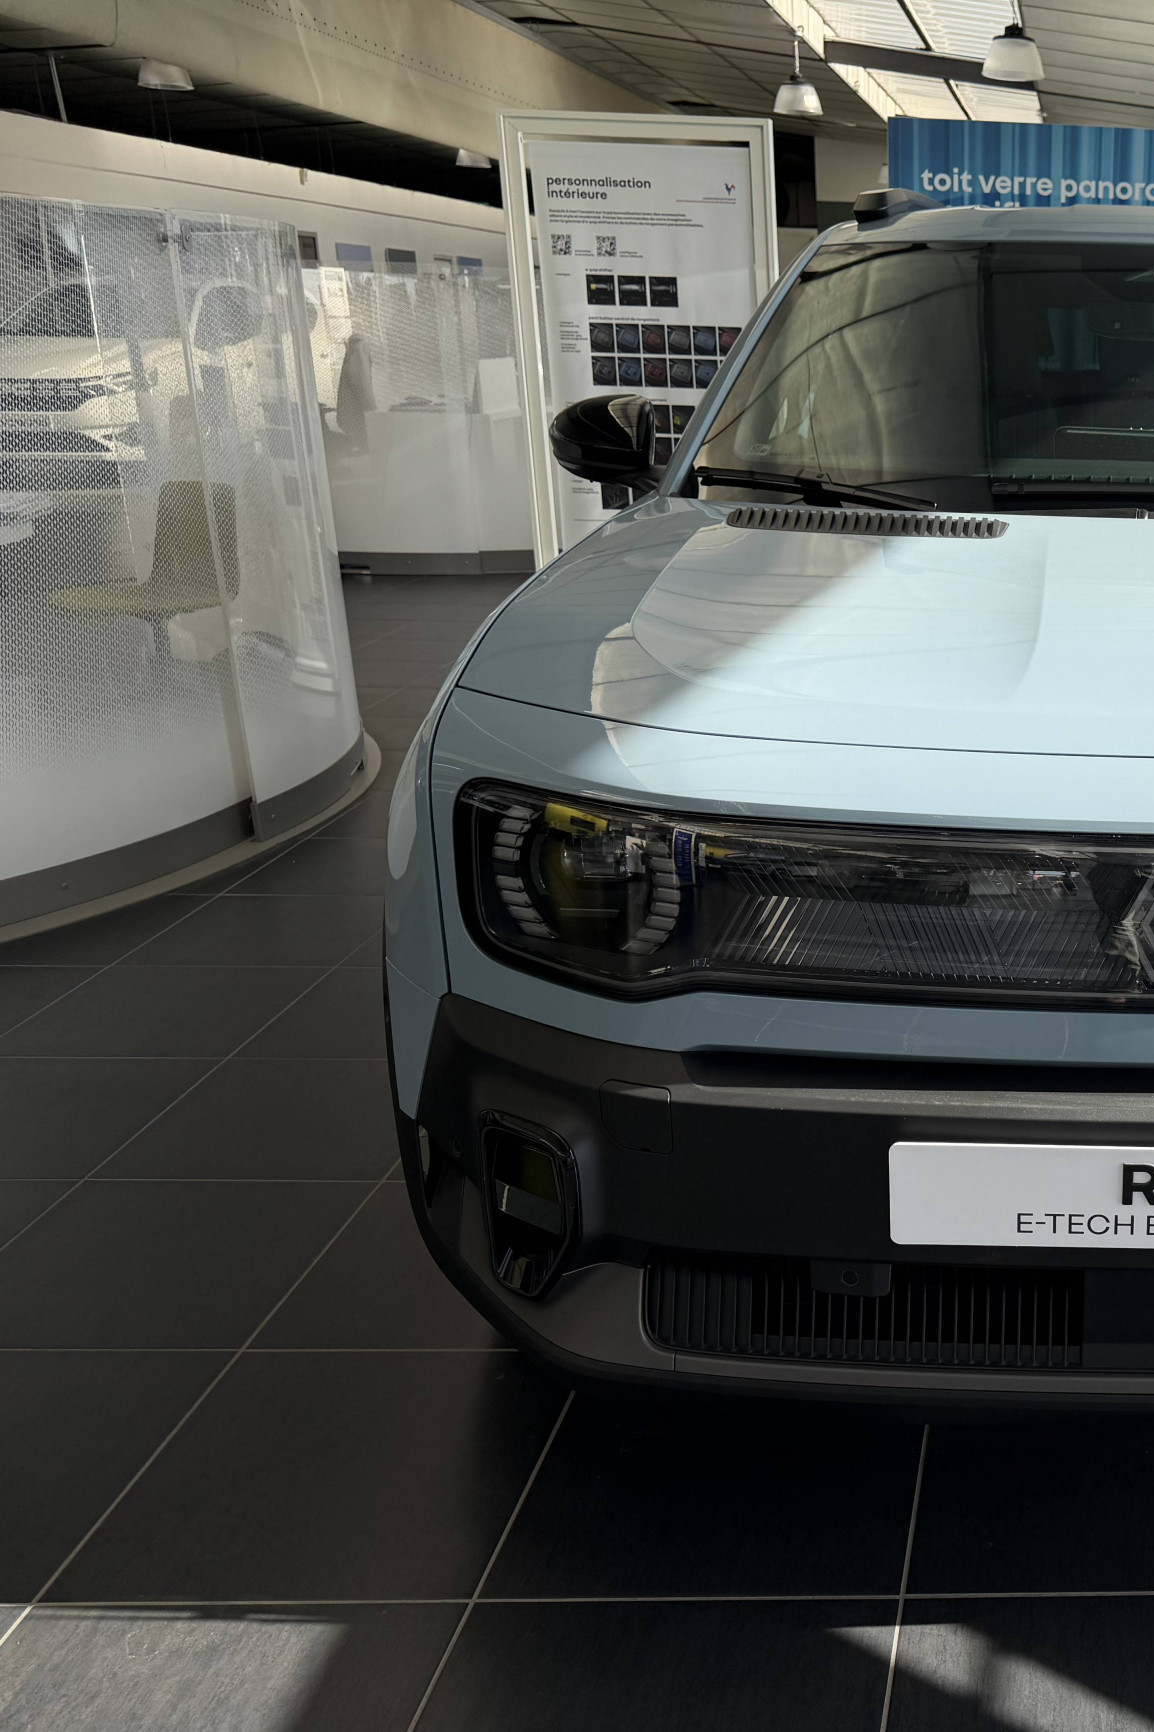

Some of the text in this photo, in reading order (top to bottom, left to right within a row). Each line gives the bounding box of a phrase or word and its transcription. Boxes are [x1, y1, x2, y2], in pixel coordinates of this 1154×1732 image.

[546, 176, 651, 189] personnalisation
[920, 167, 972, 193] toit
[978, 174, 1053, 197] verre
[547, 188, 607, 200] intérieure
[1016, 1213, 1135, 1236] E-TECH
